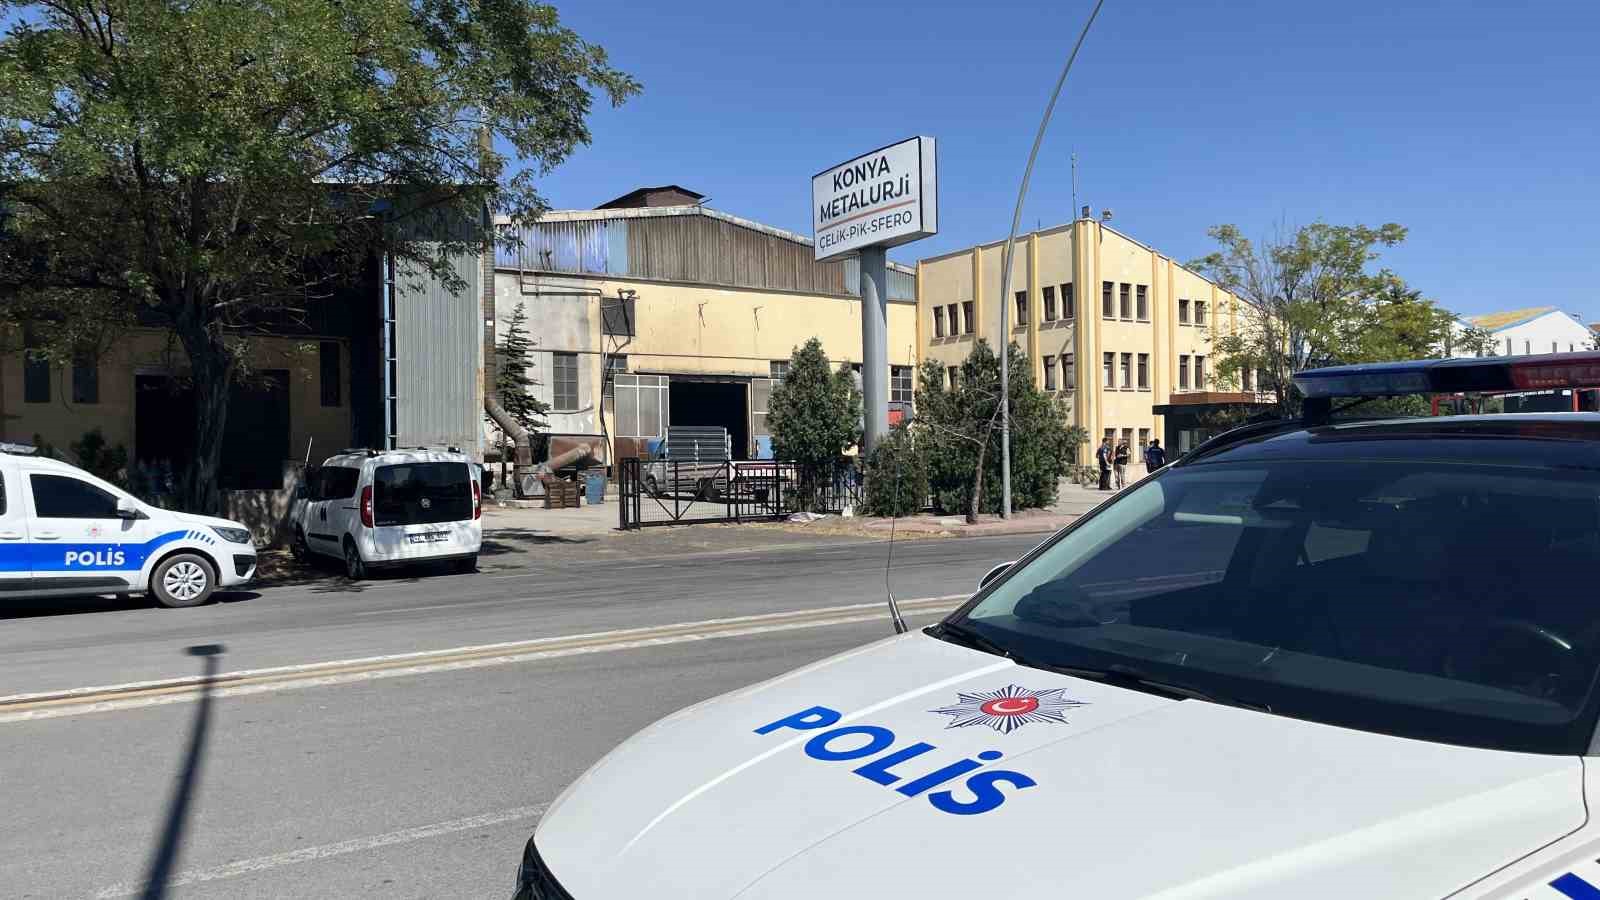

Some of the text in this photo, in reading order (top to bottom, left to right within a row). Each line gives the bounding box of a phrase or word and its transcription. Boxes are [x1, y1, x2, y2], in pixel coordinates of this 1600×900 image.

[833, 155, 890, 192] KONYA
[65, 548, 125, 566] POLİS
[753, 705, 1038, 815] POLİS
